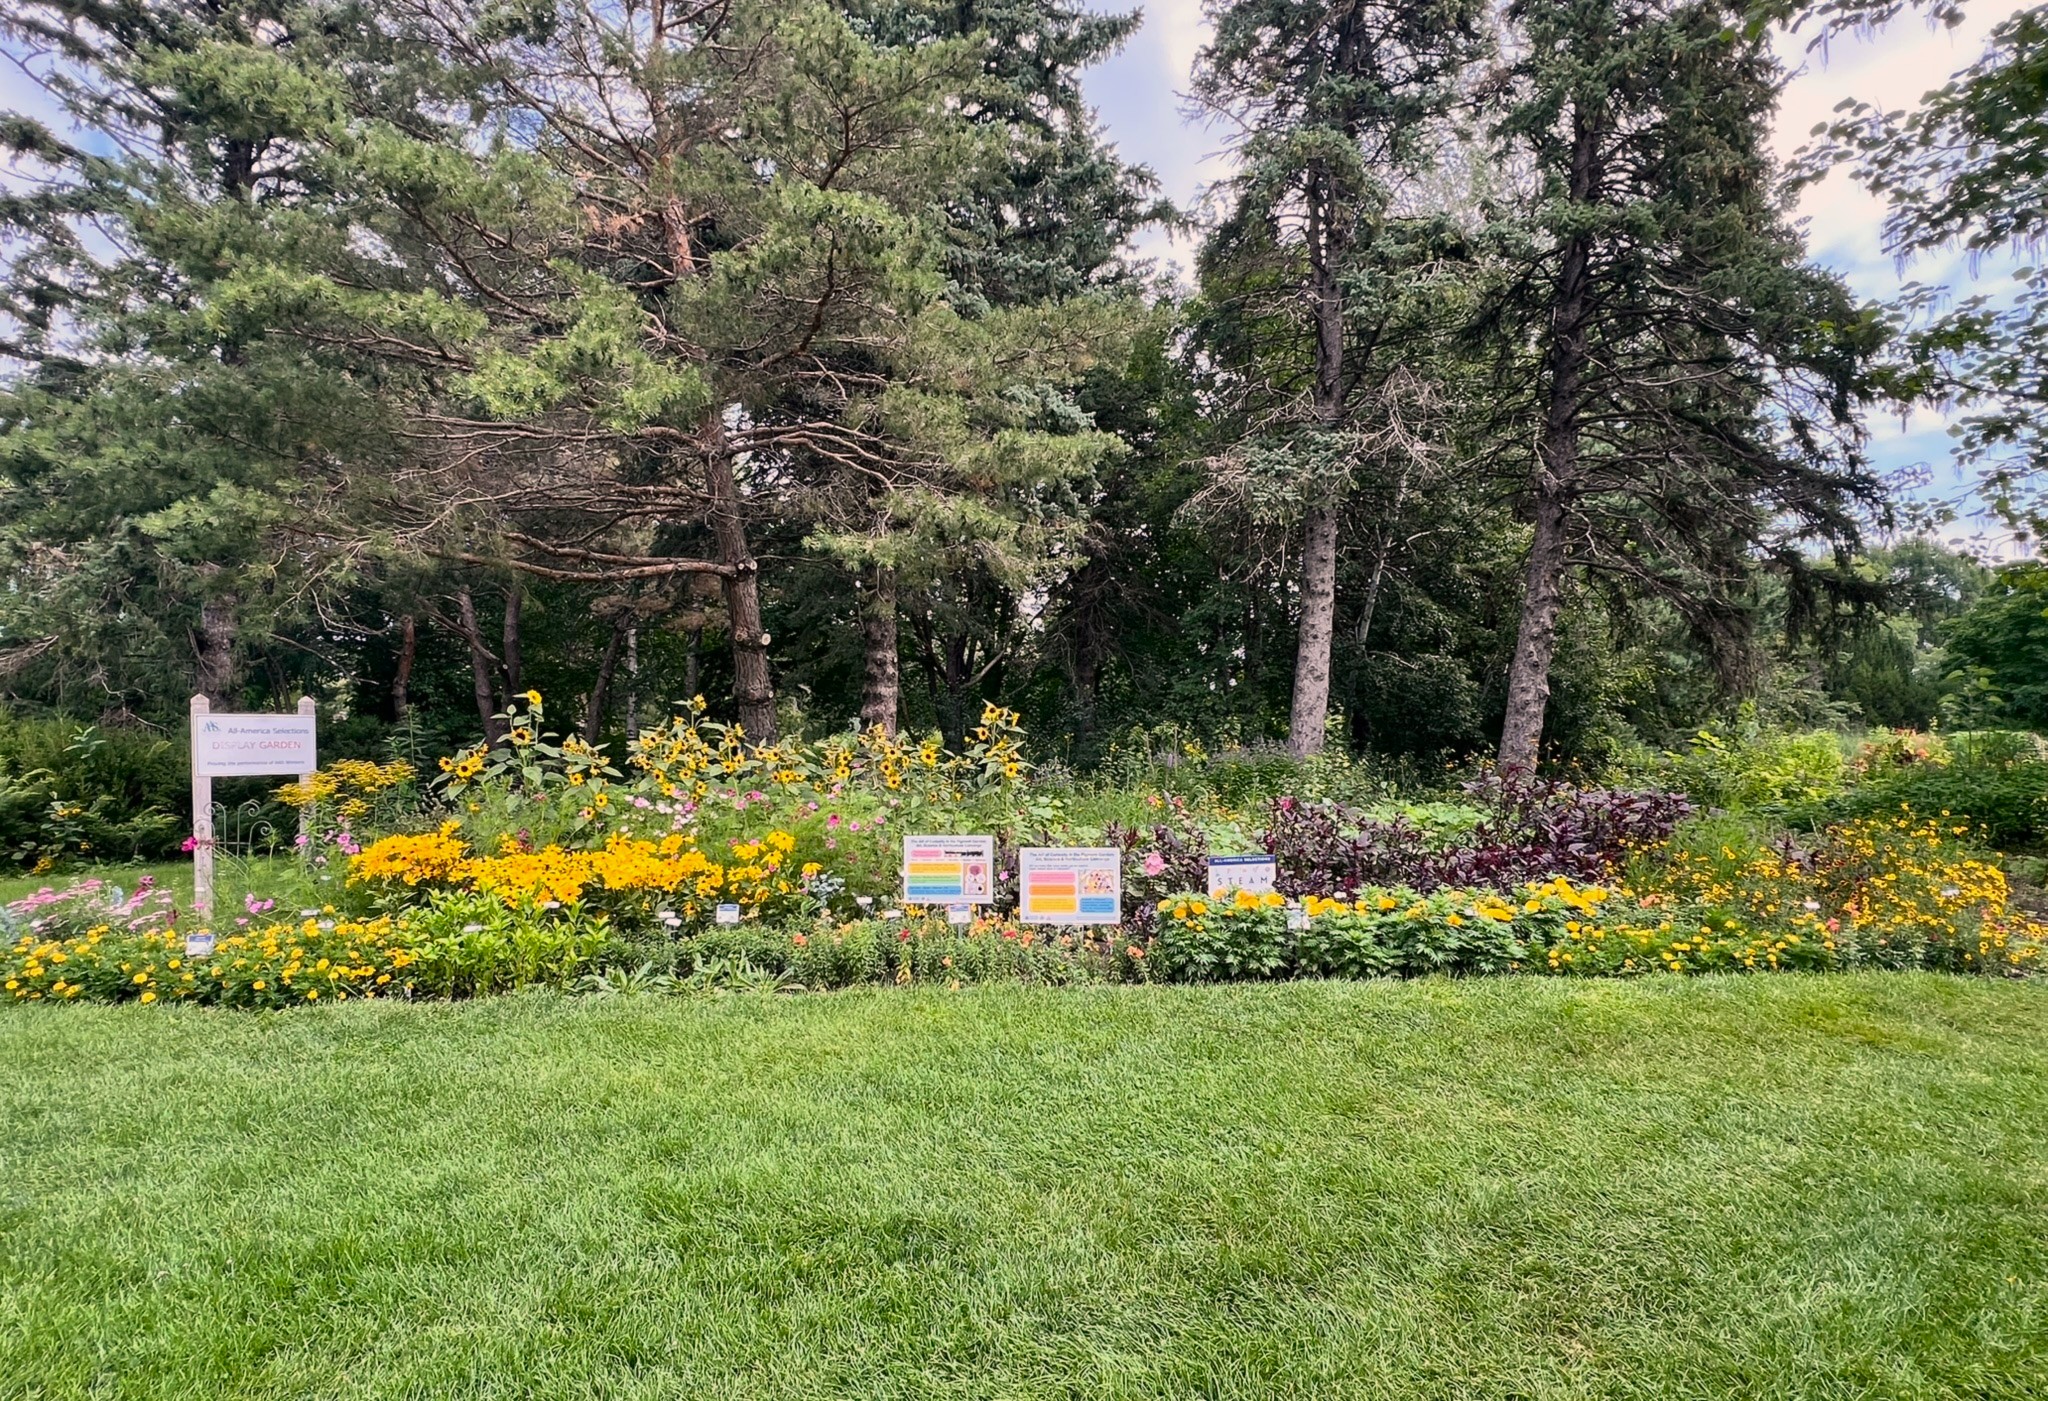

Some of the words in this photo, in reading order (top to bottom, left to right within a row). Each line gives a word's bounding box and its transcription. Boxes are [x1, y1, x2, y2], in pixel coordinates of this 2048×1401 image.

[228, 727, 271, 735] All-America
[272, 727, 310, 735] Selections
[212, 741, 256, 750] DISPLAY
[259, 741, 301, 750] GARDEN
[1217, 876, 1268, 886] STEAM
